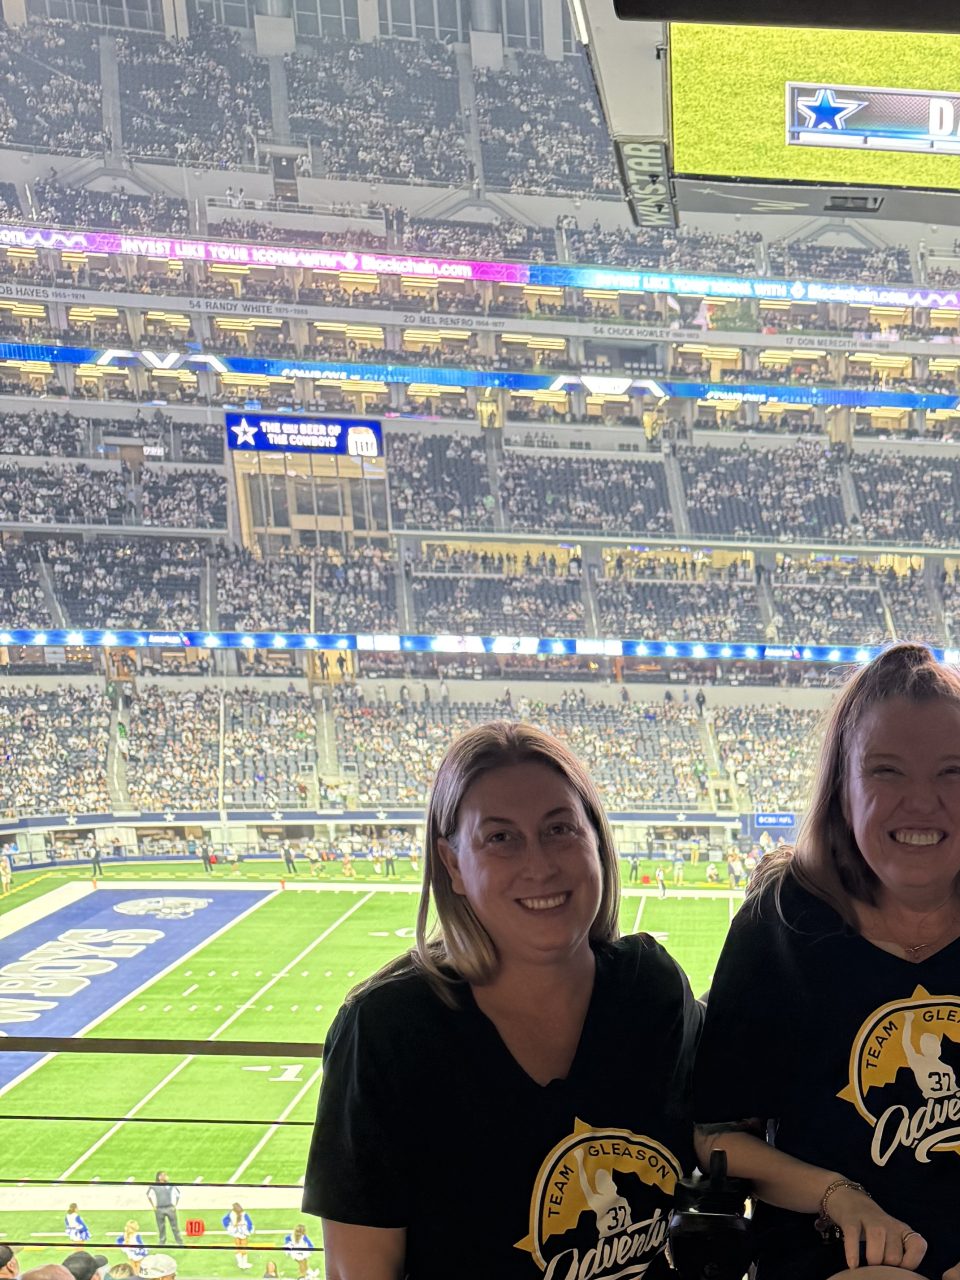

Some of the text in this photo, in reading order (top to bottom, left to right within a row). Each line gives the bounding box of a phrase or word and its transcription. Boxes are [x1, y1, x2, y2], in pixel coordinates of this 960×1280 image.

[623, 143, 672, 226] WINSTAR
[208, 245, 249, 261] YOUR
[361, 255, 472, 277] Blockchain.com
[16, 287, 49, 298] HAYES
[189, 300, 201, 310] 54
[205, 301, 239, 312] RANDY
[241, 304, 273, 314] WHITE
[419, 316, 438, 326] MEL
[439, 317, 475, 327] RENFRO
[608, 327, 635, 337] CHUCK
[636, 328, 671, 339] HOWLEY
[817, 338, 858, 348] MEREDITH
[260, 420, 282, 434] THE
[298, 423, 328, 436] BEER
[267, 433, 337, 448] THE COWBOYS
[866, 1020, 899, 1070] TEAM
[927, 1071, 951, 1093] 37
[588, 1142, 671, 1180] GLEASON
[547, 1164, 575, 1219] TEAM
[607, 1205, 628, 1231] 37
[189, 1221, 201, 1234] 10
